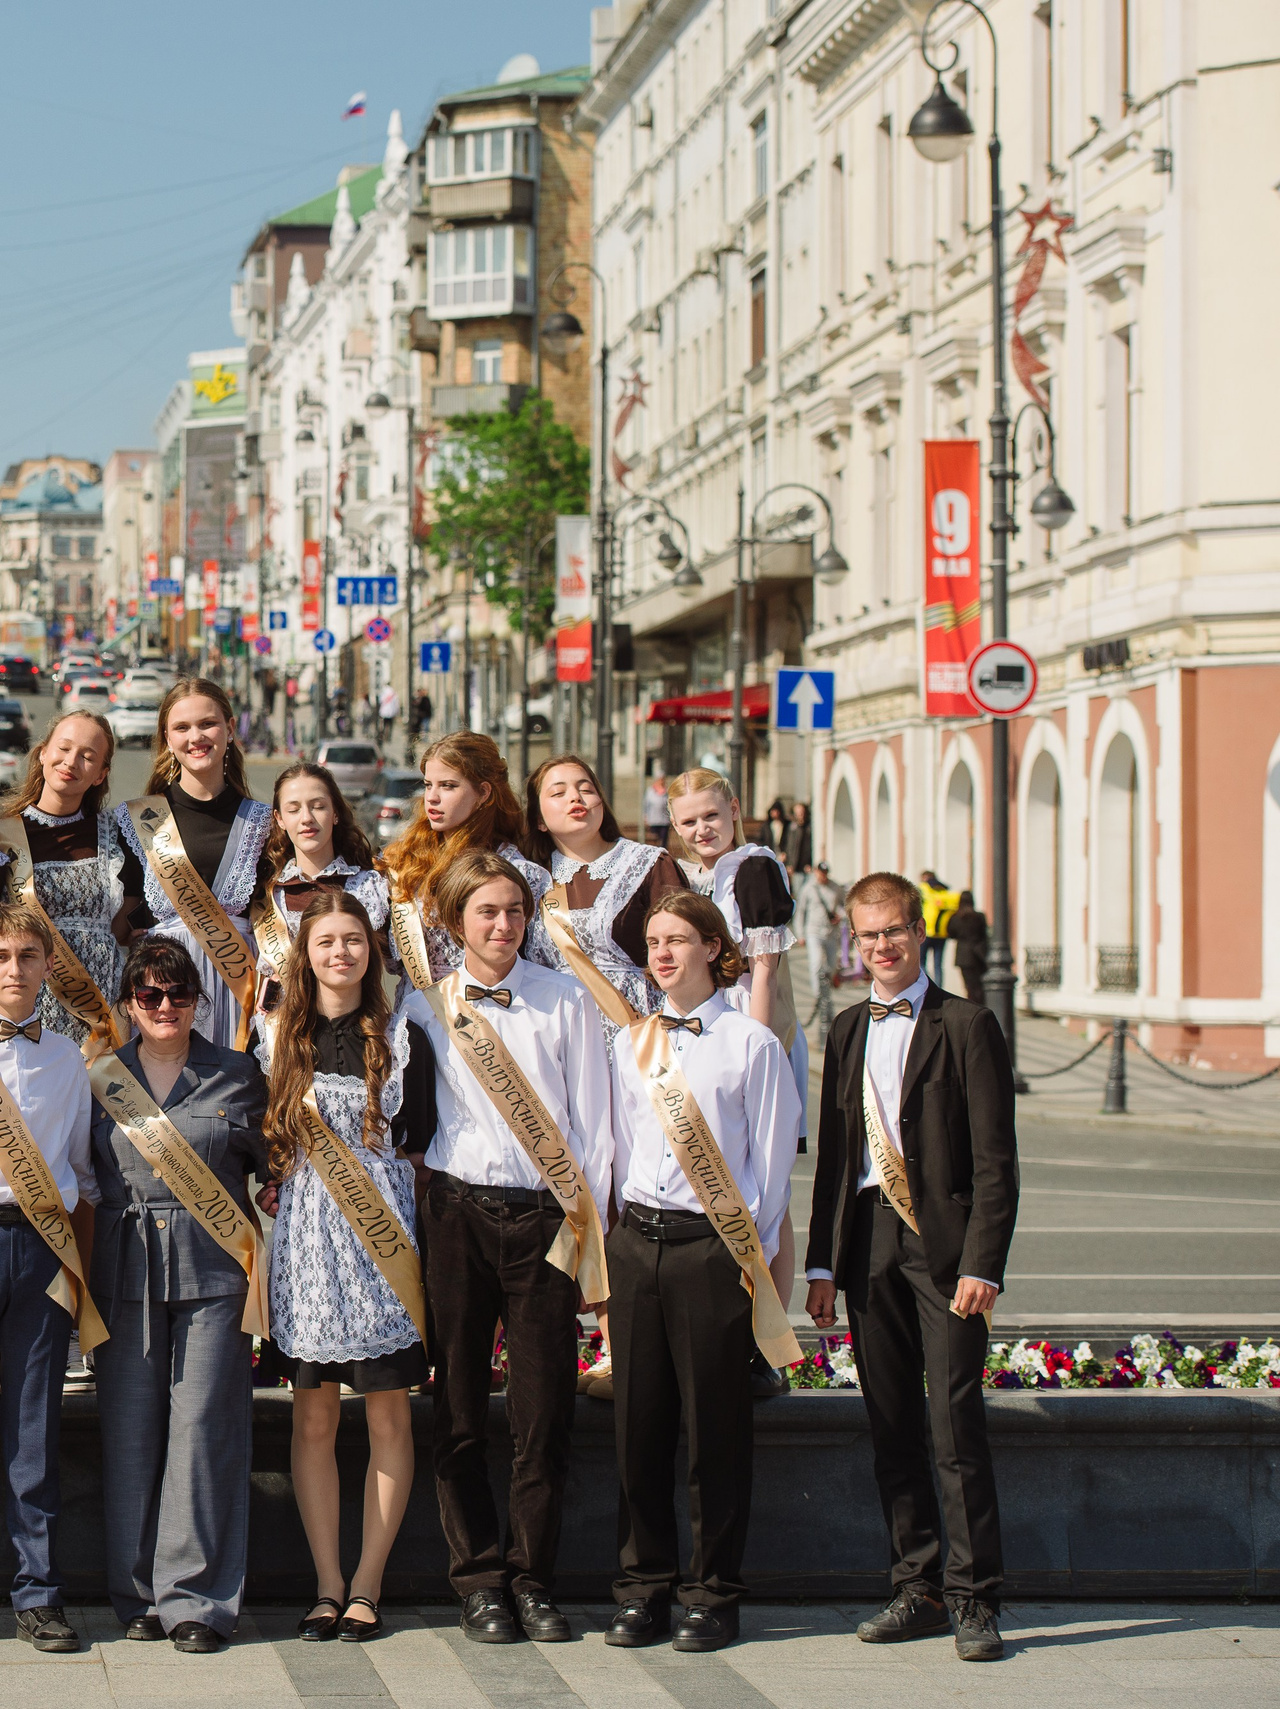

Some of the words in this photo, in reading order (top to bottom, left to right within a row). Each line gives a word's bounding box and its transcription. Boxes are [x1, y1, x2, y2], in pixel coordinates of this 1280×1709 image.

[932, 488, 970, 556] 9
[932, 557, 970, 577] МАЯ
[151, 833, 220, 936] Выпускница
[206, 932, 253, 978] 2025
[178, 856, 204, 893] Кузнецова
[200, 895, 220, 916] Алеся
[61, 982, 111, 1023] 2025
[472, 1039, 550, 1153] Выпускник
[538, 1148, 583, 1198] 2025
[506, 1061, 533, 1099] Кормаченко
[531, 1099, 554, 1131] Владимир
[13, 1119, 32, 1153] Грицюк
[28, 1151, 52, 1190] Севастьян
[122, 1101, 158, 1140] Классный
[147, 1139, 203, 1198] руководитель
[194, 1190, 244, 1238] 2025
[349, 1159, 372, 1192] Валерия
[664, 1089, 727, 1209] Выпускник
[714, 1207, 756, 1255] 2025
[692, 1115, 715, 1154] Усманов
[713, 1155, 732, 1188] Данила
[32, 1205, 72, 1249] 2025
[356, 1209, 407, 1258] 2025
